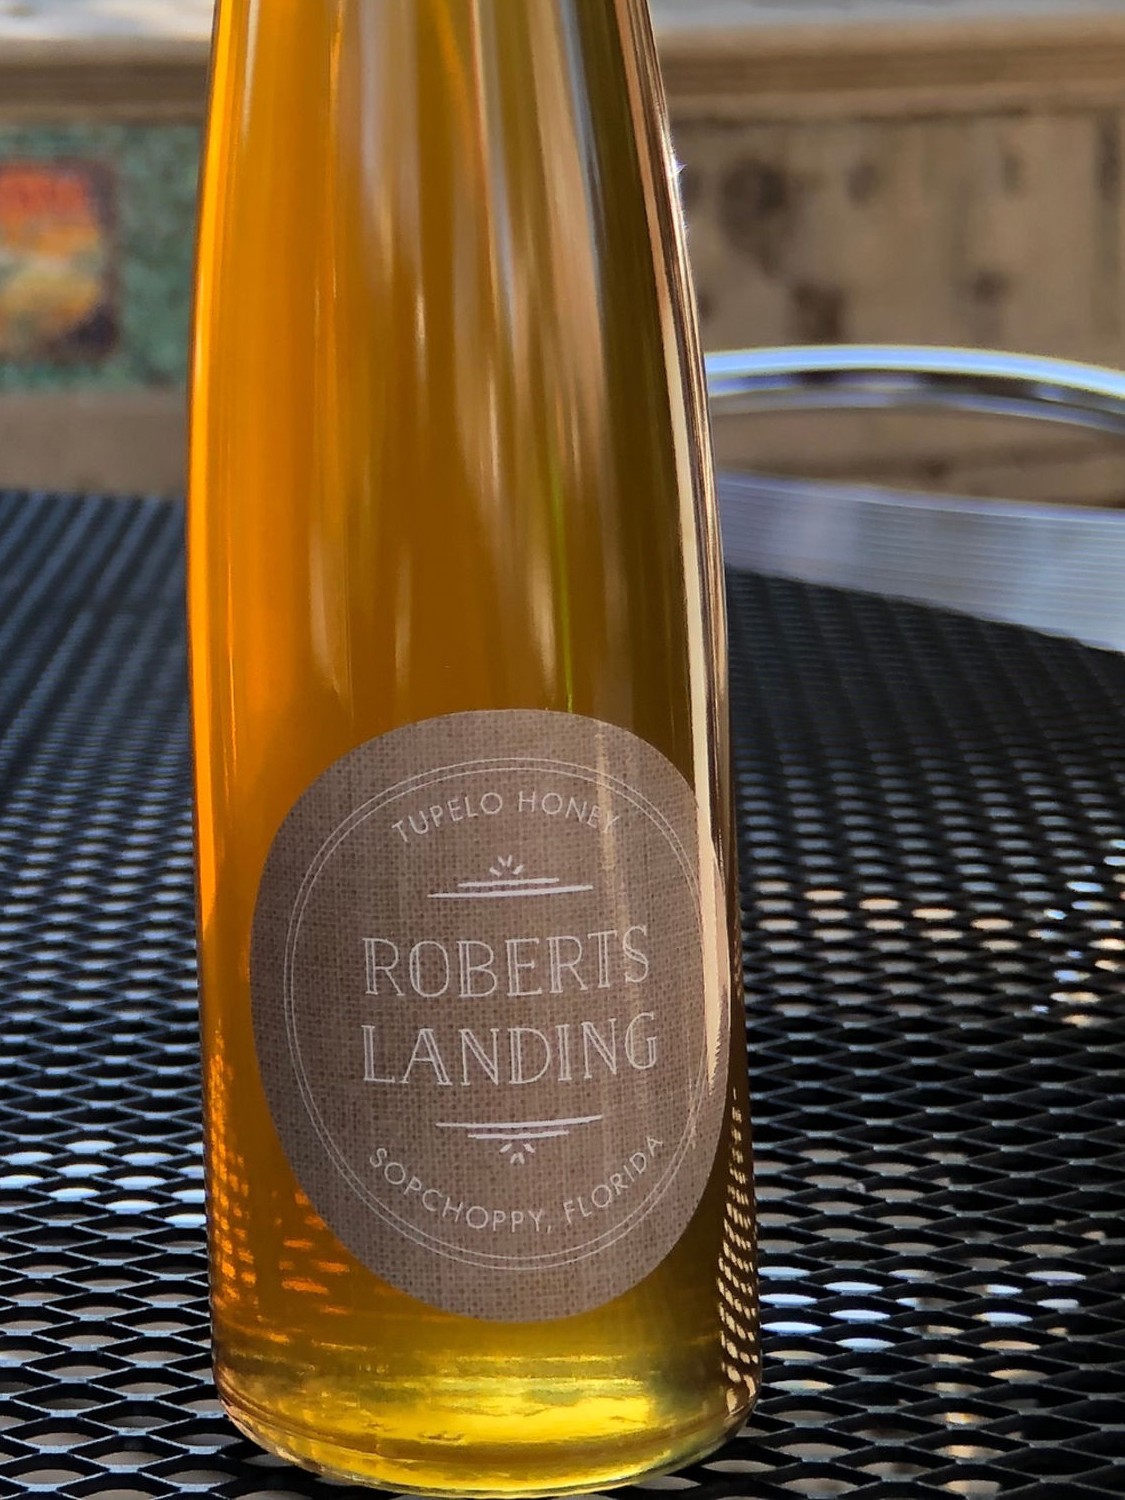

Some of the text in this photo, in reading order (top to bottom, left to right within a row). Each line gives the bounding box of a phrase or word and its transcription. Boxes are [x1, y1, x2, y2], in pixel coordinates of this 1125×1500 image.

[391, 790, 621, 843] TUPELO HONEY
[362, 924, 650, 998] ROBERTS
[361, 1012, 658, 1086] LANDING
[369, 1135, 664, 1233] SOPCHOPPY, FLORIDA
